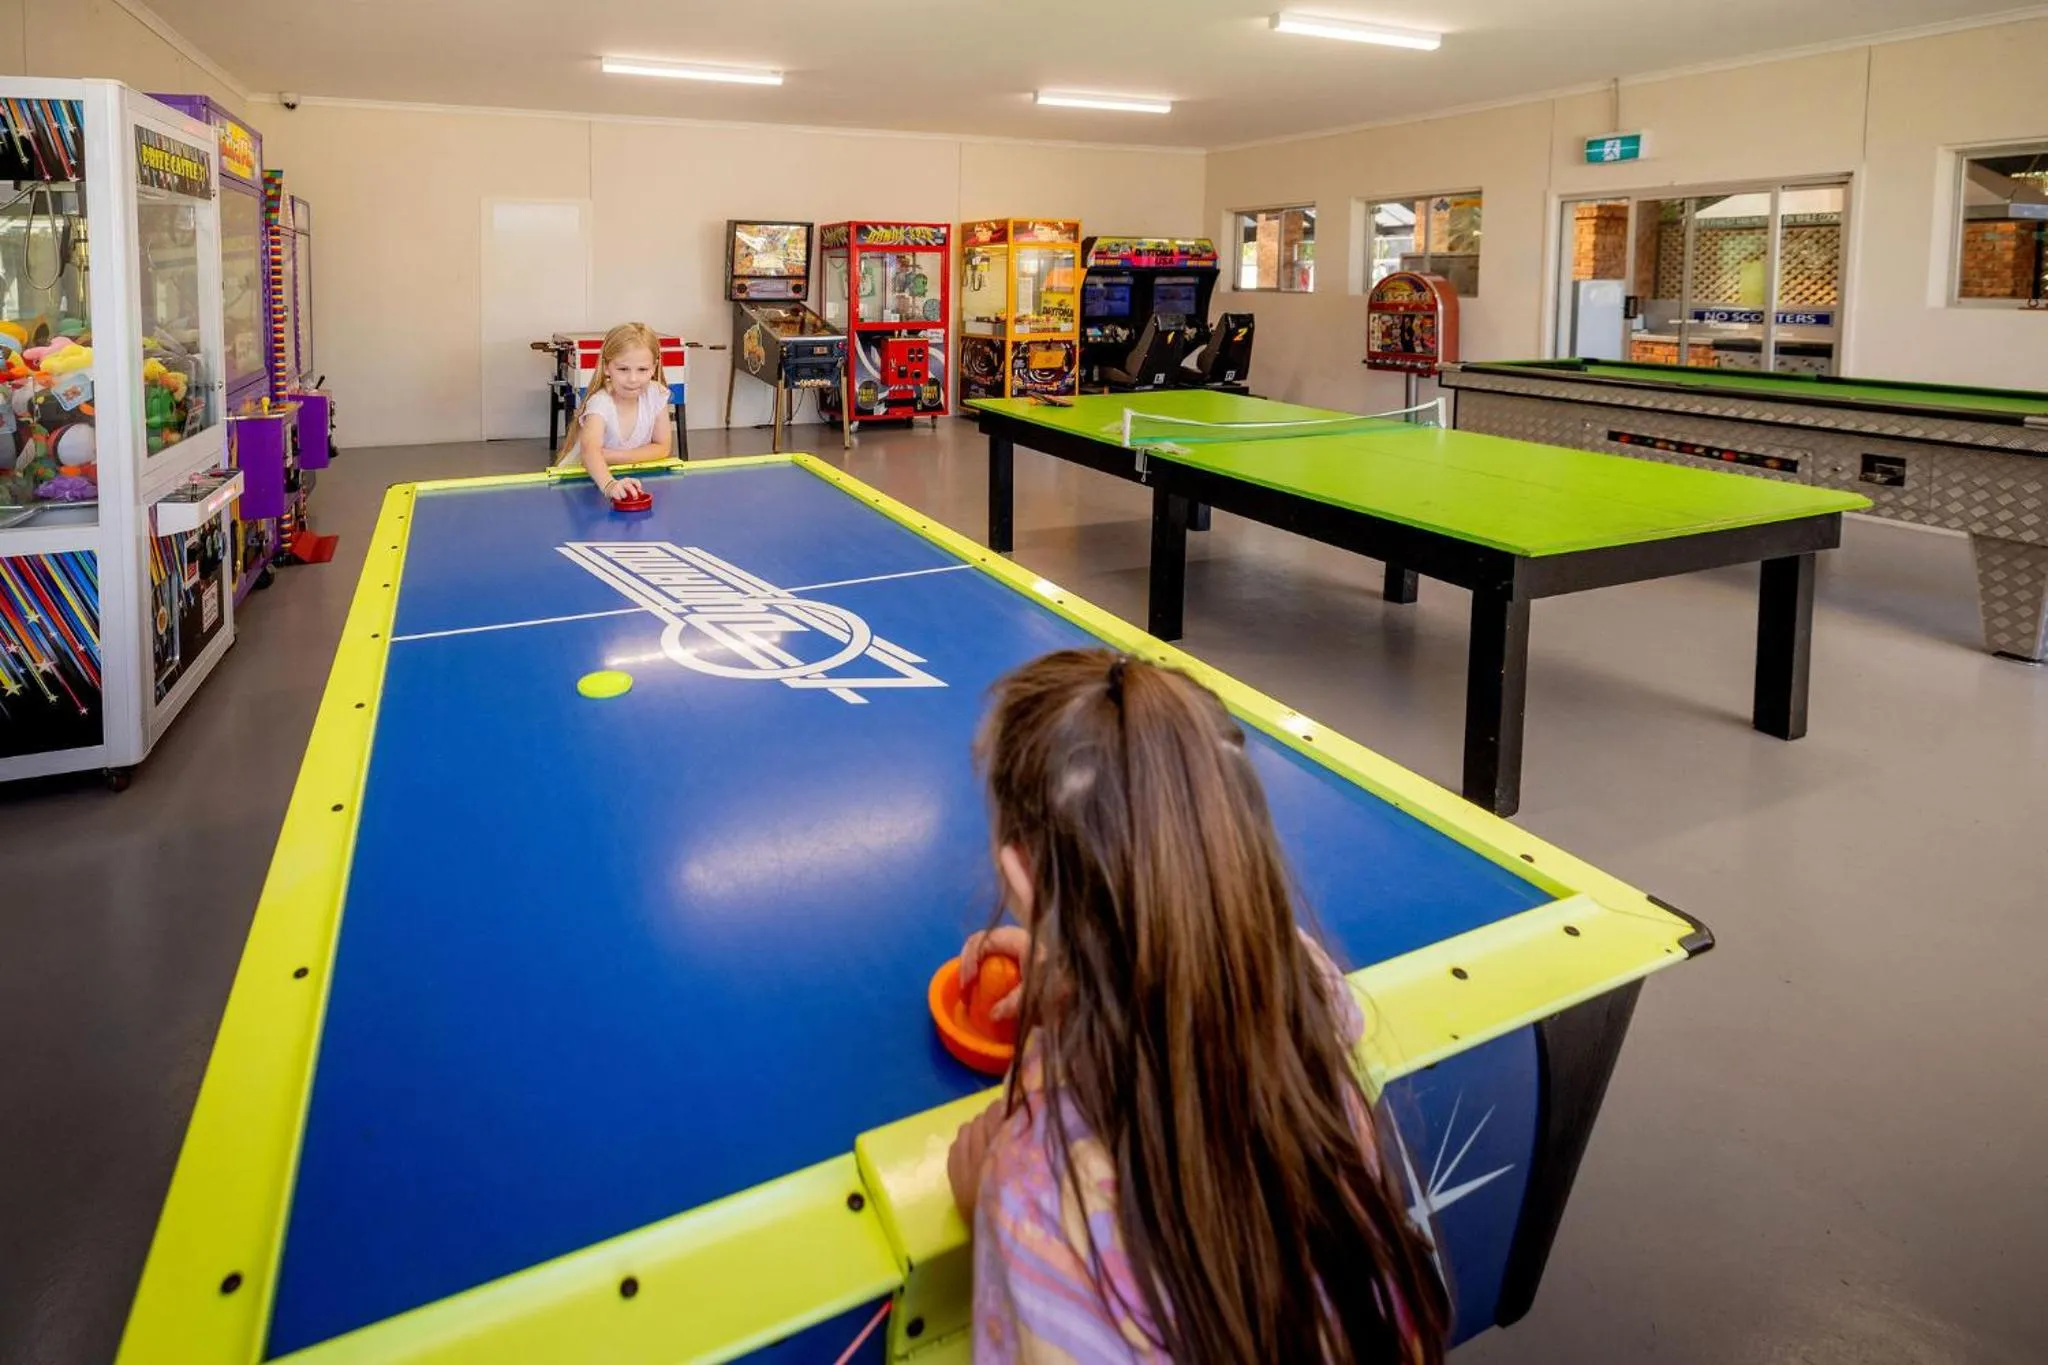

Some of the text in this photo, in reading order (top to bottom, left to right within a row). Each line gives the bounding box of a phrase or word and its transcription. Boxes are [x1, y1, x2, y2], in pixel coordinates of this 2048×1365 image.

[142, 143, 170, 172] PRIZE
[171, 155, 199, 181] CASTLE
[1135, 248, 1175, 257] DAYTONA
[1155, 256, 1175, 265] USA
[1704, 311, 1817, 323] NO SCOTERS
[1233, 327, 1249, 342] 2
